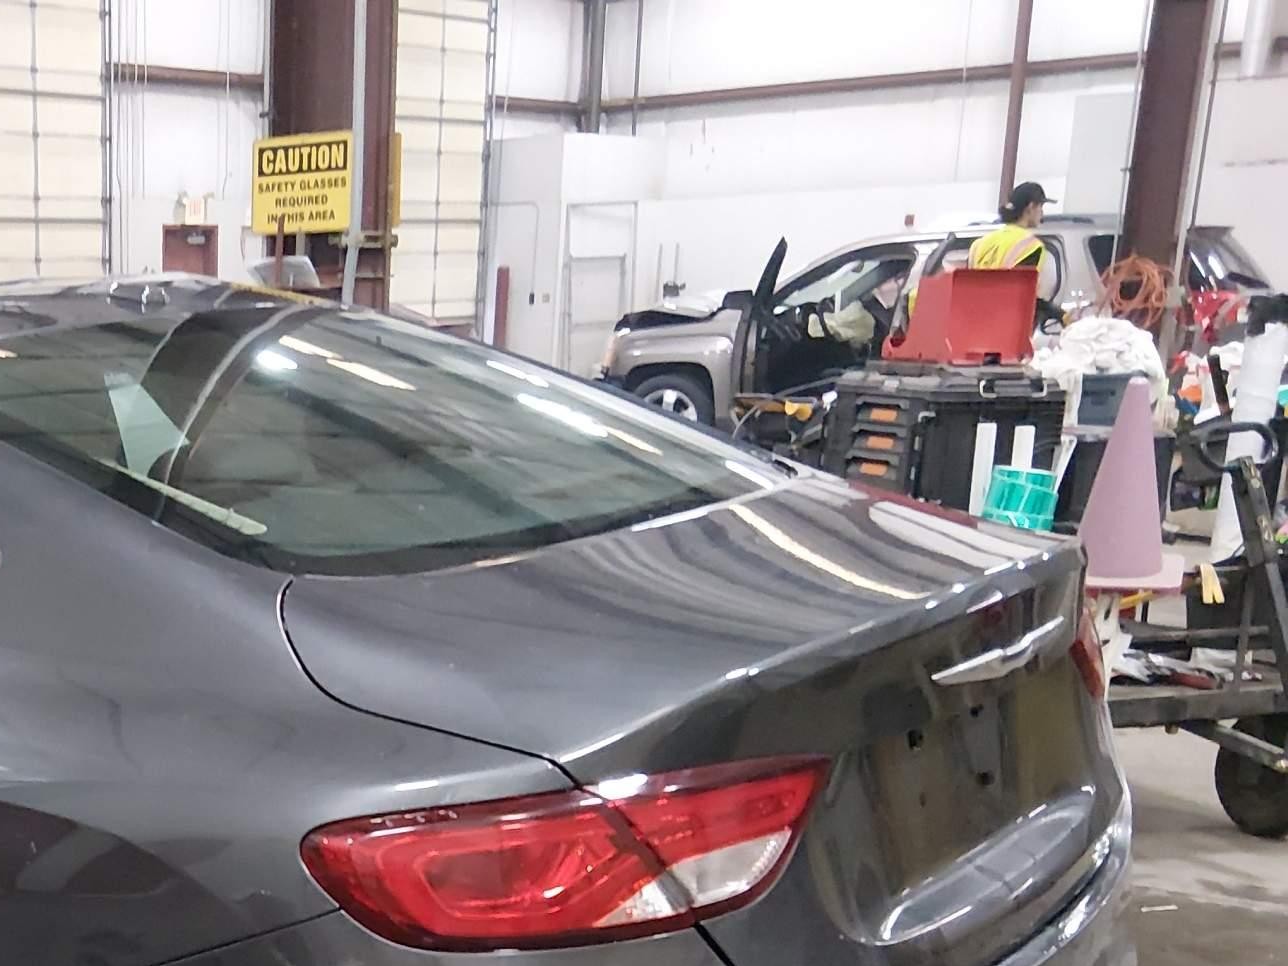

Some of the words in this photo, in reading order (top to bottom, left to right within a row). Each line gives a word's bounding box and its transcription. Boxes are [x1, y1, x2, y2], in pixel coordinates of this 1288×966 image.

[262, 143, 344, 174] CAUTION
[258, 179, 296, 194] SAFETY
[299, 176, 346, 192] GLASSES
[275, 194, 328, 208] REQUIRED
[308, 209, 335, 222] AREA
